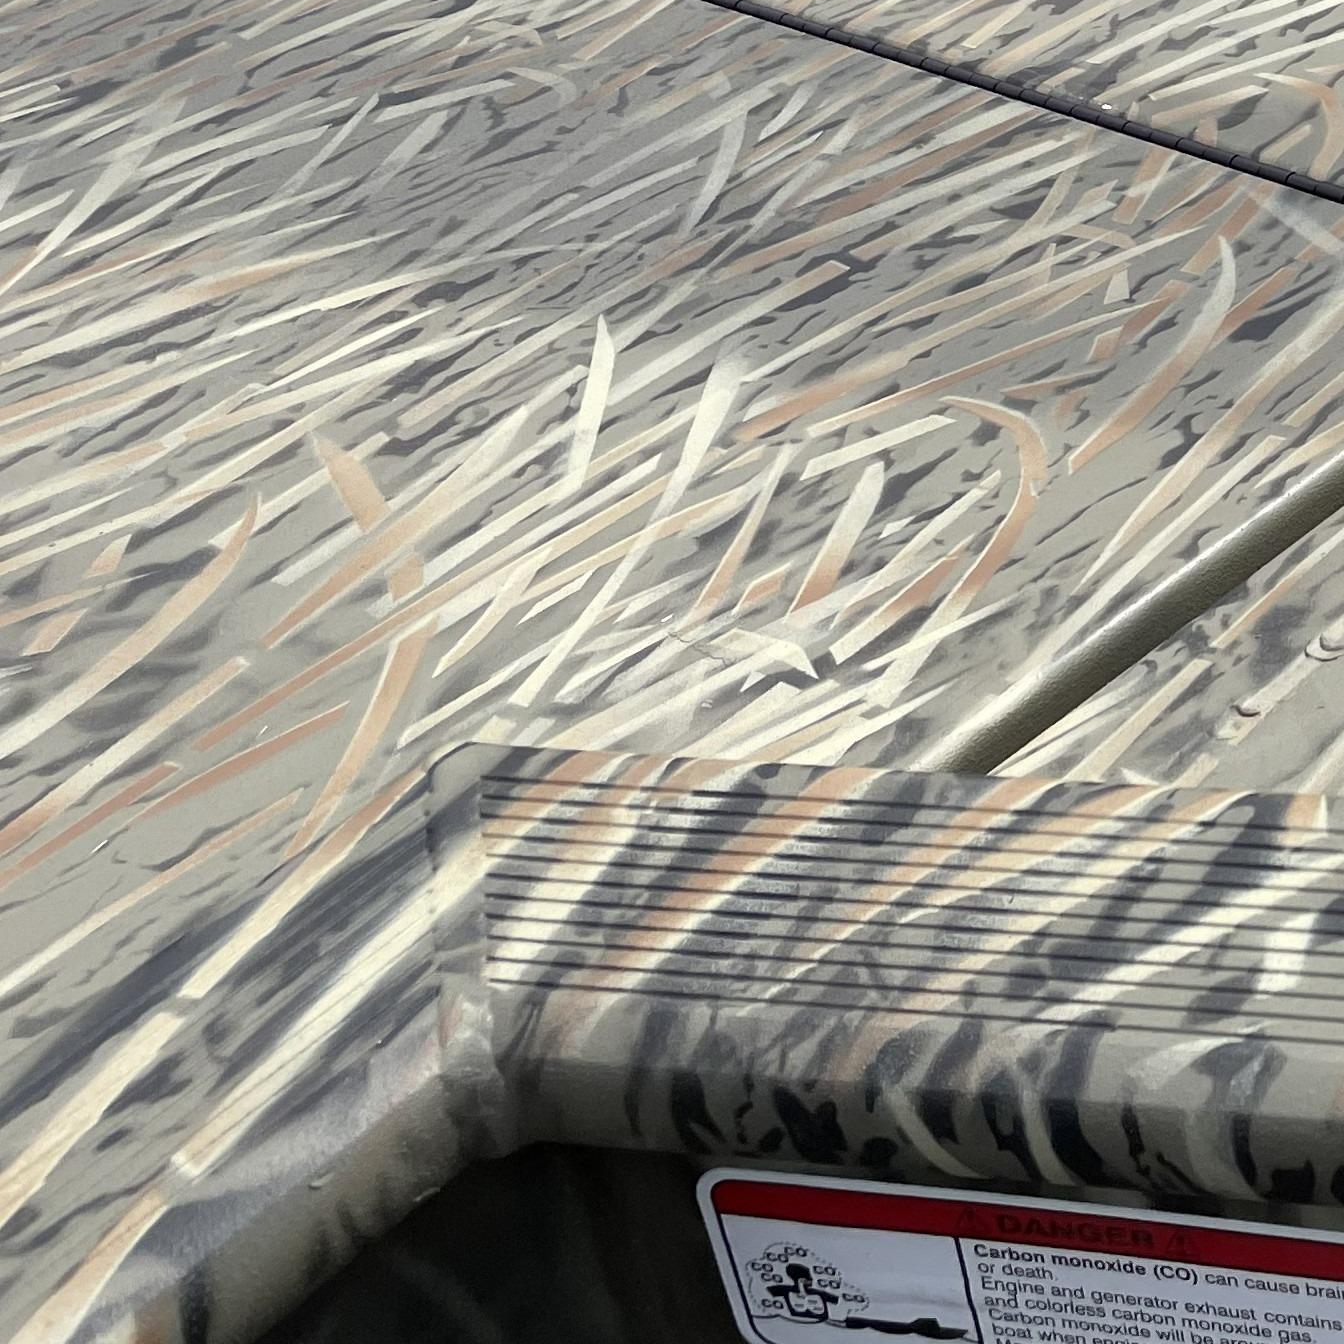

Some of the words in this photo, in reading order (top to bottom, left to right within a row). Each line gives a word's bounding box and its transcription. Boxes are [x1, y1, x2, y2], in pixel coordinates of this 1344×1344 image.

[996, 1215, 1154, 1245] DANGER
[784, 1246, 807, 1257] CO
[766, 1252, 789, 1263] CO
[751, 1262, 774, 1273] CO
[813, 1265, 836, 1276] CO
[973, 1244, 1045, 1264] Carbon
[1050, 1253, 1147, 1276] monoxide
[1153, 1264, 1199, 1285] (CO)
[1204, 1273, 1239, 1288] can
[1244, 1278, 1300, 1295] cause
[977, 1262, 995, 1274] or
[1001, 1263, 1058, 1281] death.
[761, 1272, 783, 1283] CO
[817, 1278, 841, 1289] CO
[761, 1298, 784, 1309] CO
[842, 1293, 865, 1303] CO
[981, 1276, 1045, 1296] Engine
[1050, 1285, 1085, 1299] and
[1090, 1290, 1178, 1311] generator
[1184, 1301, 1257, 1321] exhaust
[1264, 1312, 1343, 1332] contains
[984, 1293, 1019, 1308] and
[1025, 1297, 1106, 1317] colorless
[1111, 1308, 1176, 1326] carbon
[1181, 1316, 1272, 1338] monoxide
[1278, 1328, 1317, 1344] gas.
[988, 1308, 1056, 1327] Carbon
[1061, 1317, 1151, 1338] monoxide
[1155, 1328, 1185, 1342] will
[1190, 1331, 1214, 1344] be
[992, 1323, 1033, 1339] boat
[1038, 1329, 1086, 1344] when
